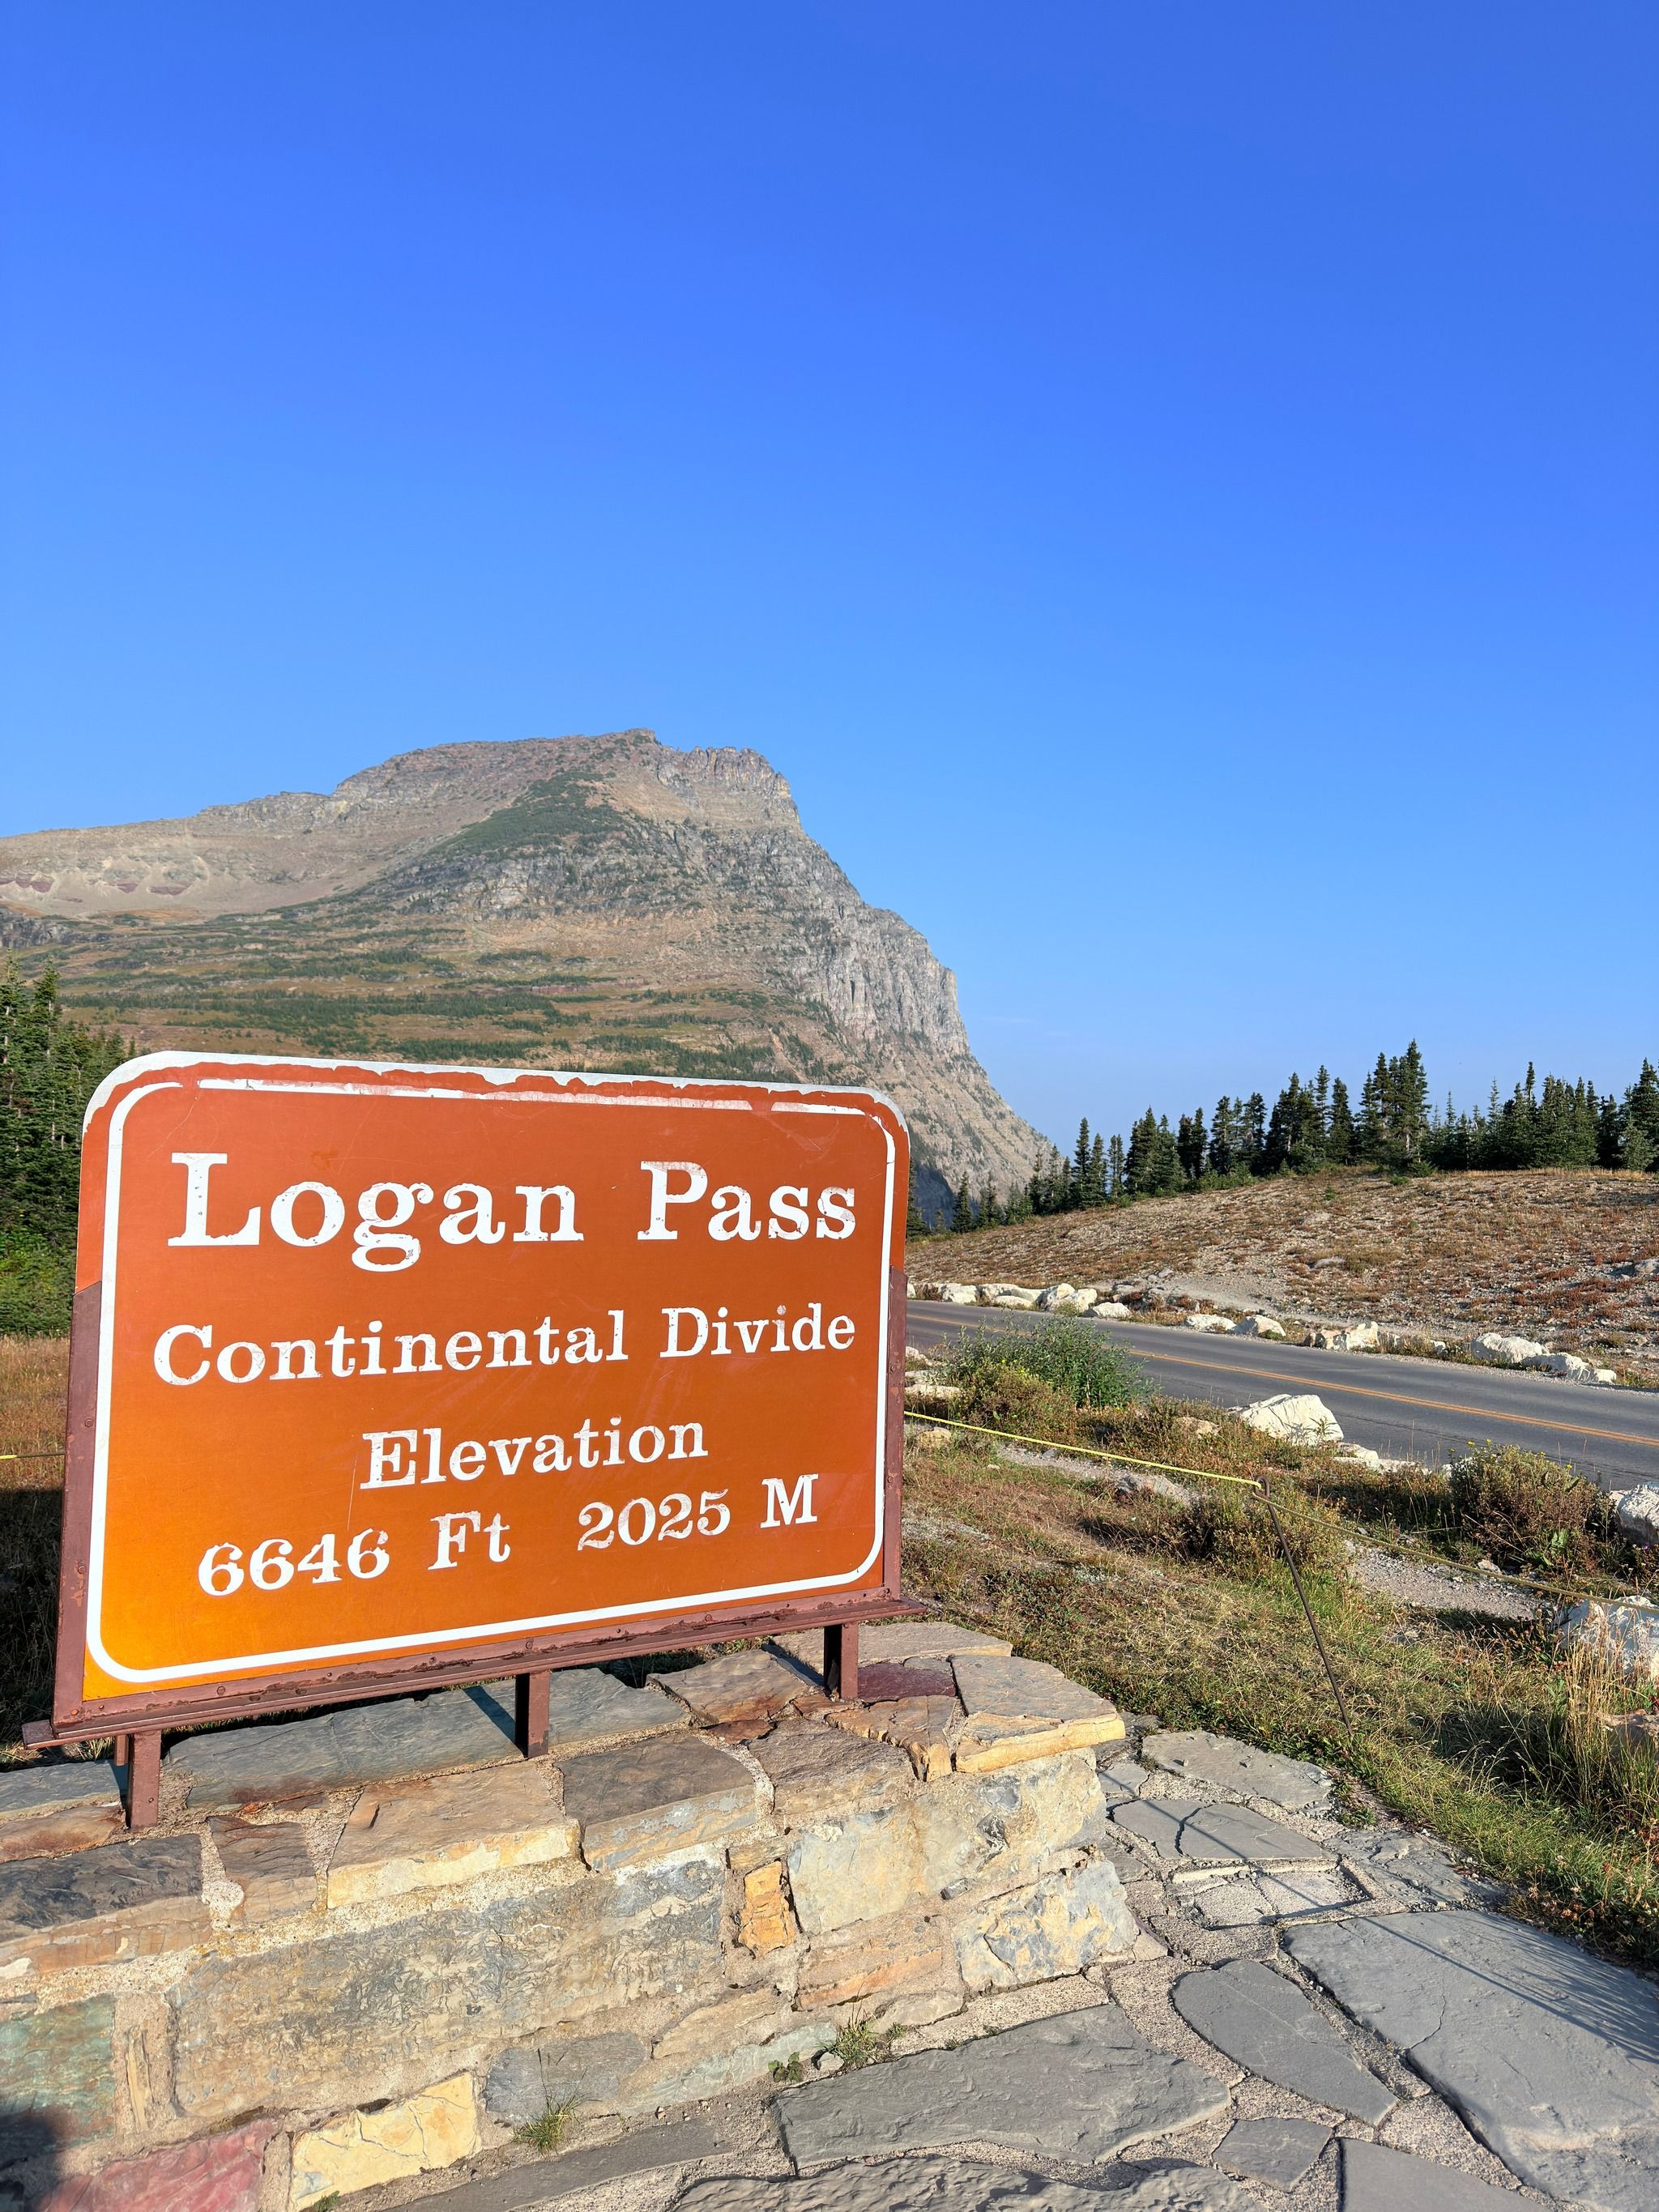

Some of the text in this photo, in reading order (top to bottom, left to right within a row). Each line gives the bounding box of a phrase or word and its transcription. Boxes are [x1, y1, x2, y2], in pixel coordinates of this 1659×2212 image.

[167, 1152, 857, 1273] Logan Pass
[152, 1302, 856, 1387] Continental Divide
[359, 1415, 710, 1490] Elevation
[198, 1473, 820, 1596] 6646 Ft 2025 M
